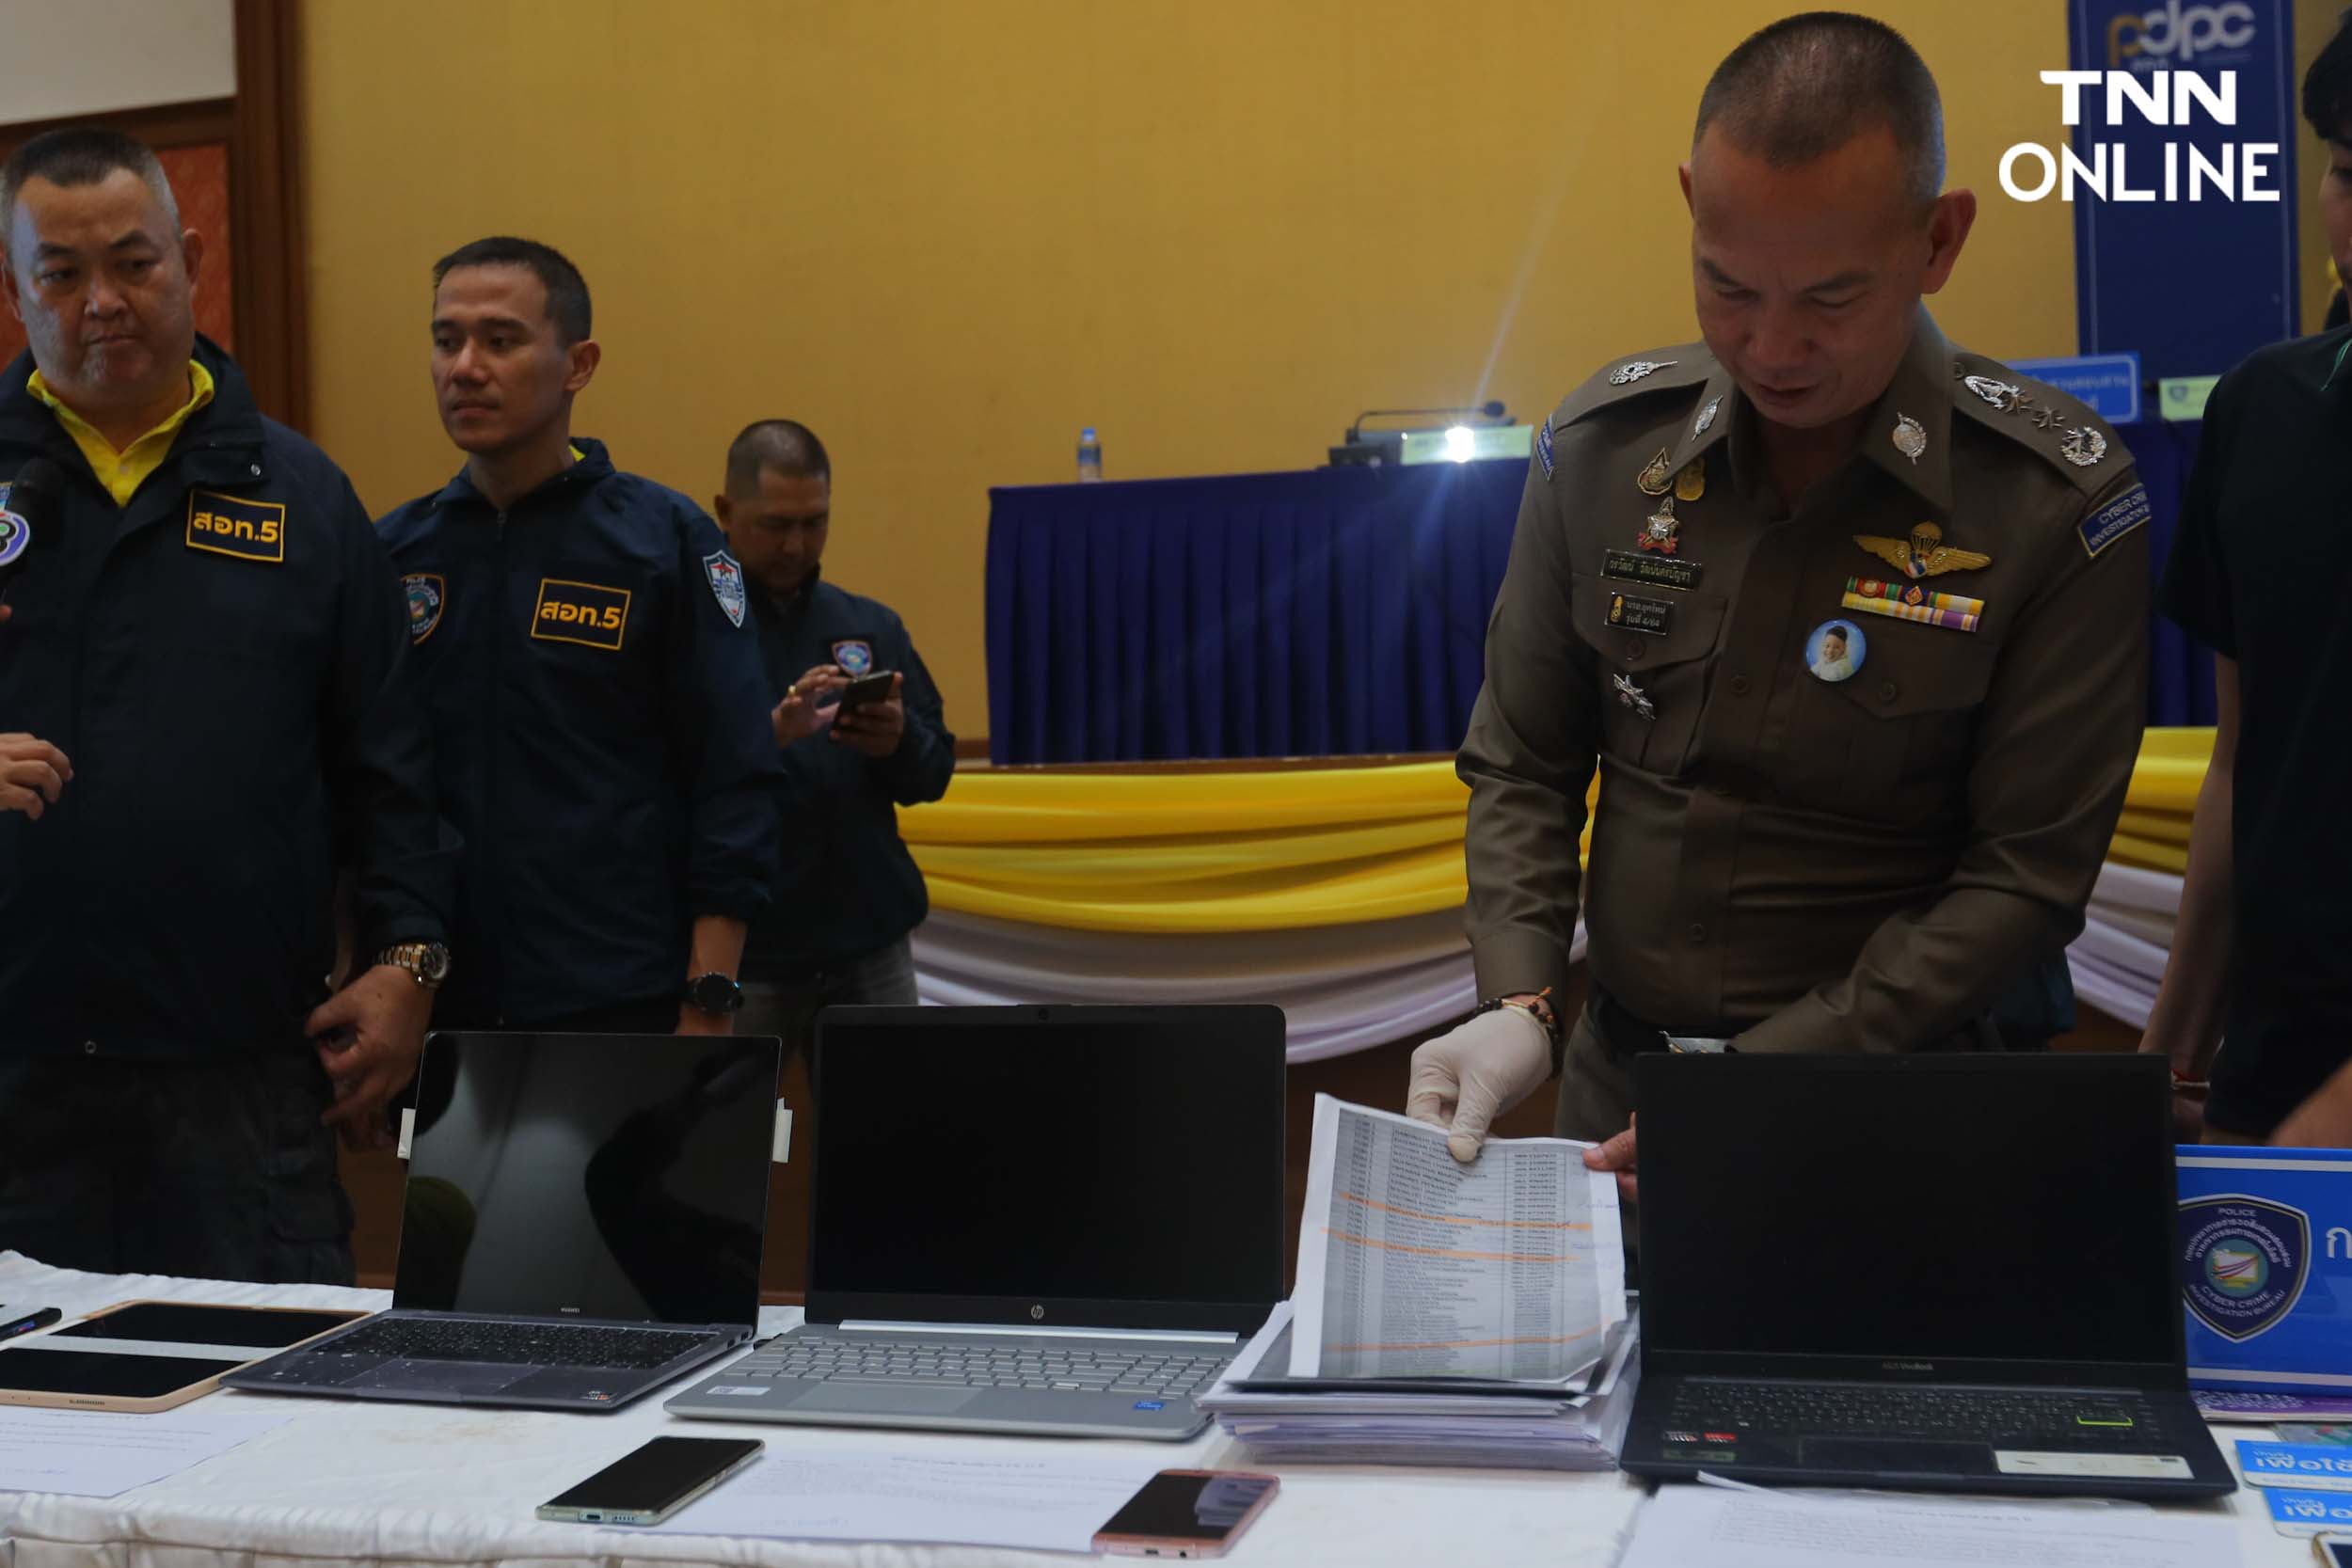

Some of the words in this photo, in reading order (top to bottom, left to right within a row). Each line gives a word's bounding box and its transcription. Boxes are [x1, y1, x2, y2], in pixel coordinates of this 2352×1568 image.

[2107, 0, 2256, 68] pdpc
[193, 512, 278, 543] สอท.5
[540, 601, 622, 630] สอท.5
[2217, 1207, 2257, 1217] POLICE
[2202, 1286, 2236, 1307] CYBER
[2238, 1291, 2271, 1309] CRIME
